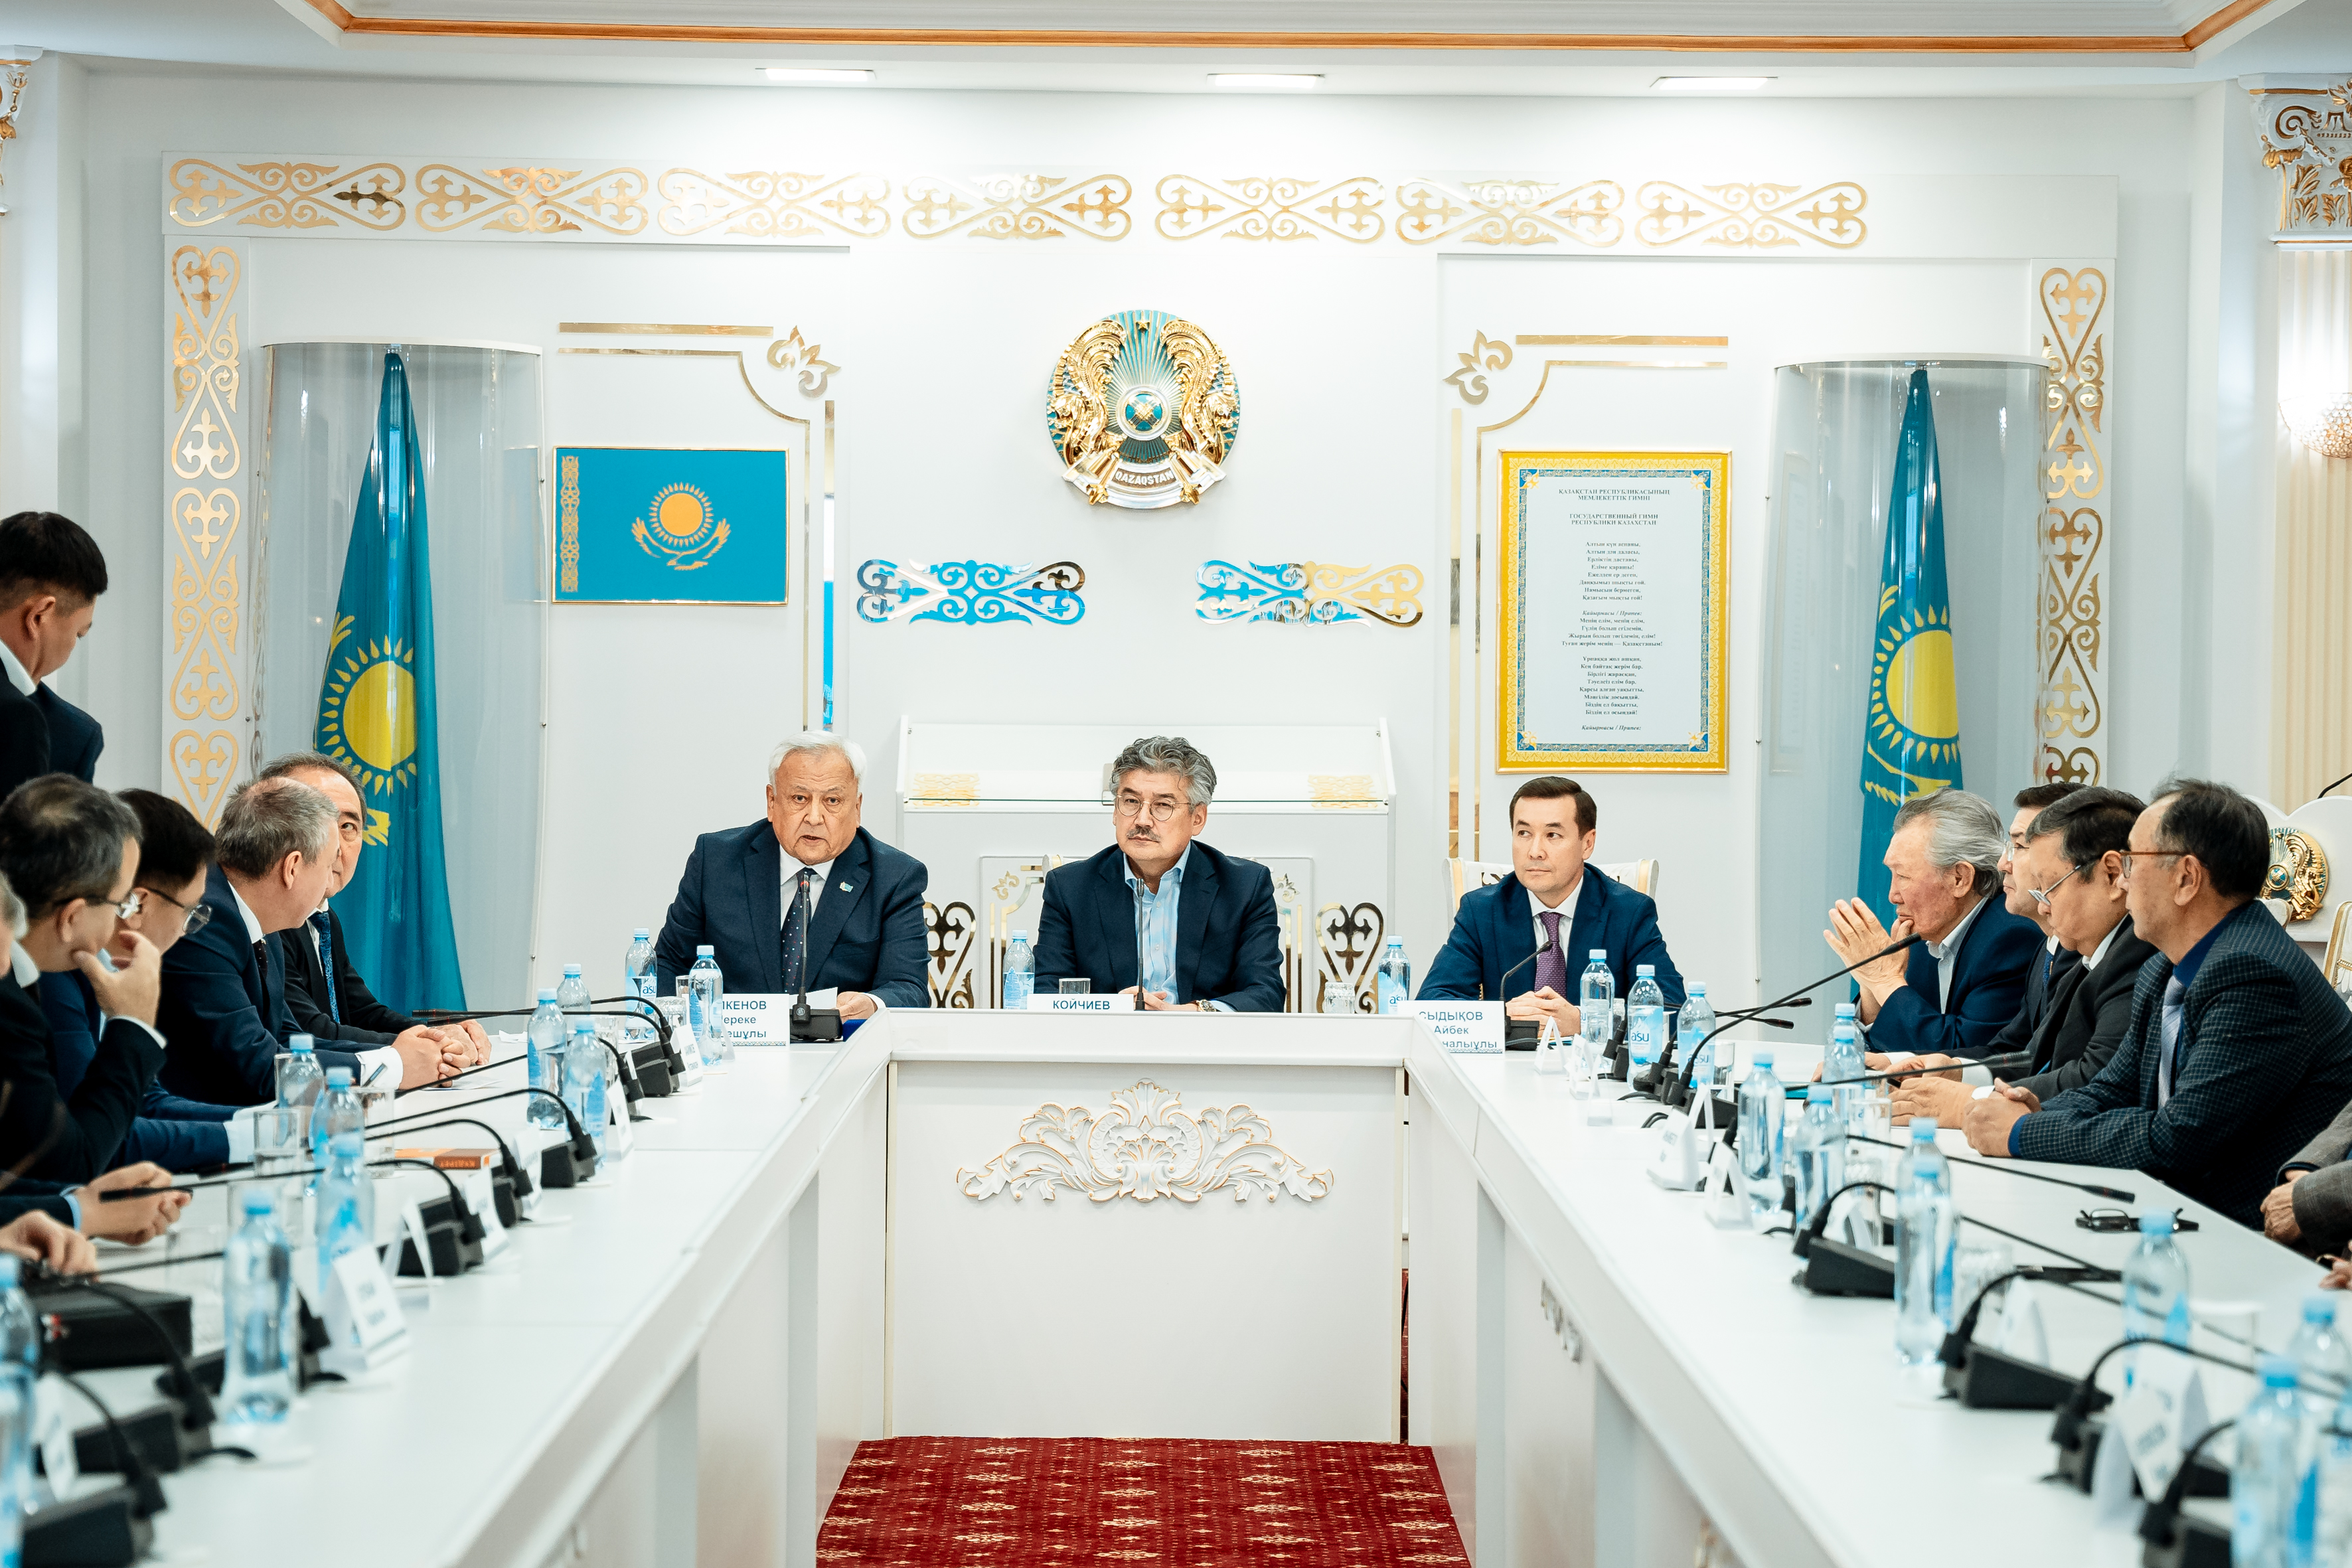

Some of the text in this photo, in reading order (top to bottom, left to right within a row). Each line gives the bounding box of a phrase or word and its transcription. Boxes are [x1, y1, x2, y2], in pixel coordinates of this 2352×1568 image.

[1115, 470, 1174, 486] QAZAQSTAN
[1053, 998, 1110, 1010] КОЙЧИЕВ
[721, 1015, 756, 1026] ереке
[1434, 1026, 1469, 1034] Айбек
[1442, 1041, 1497, 1050] чалыұлы
